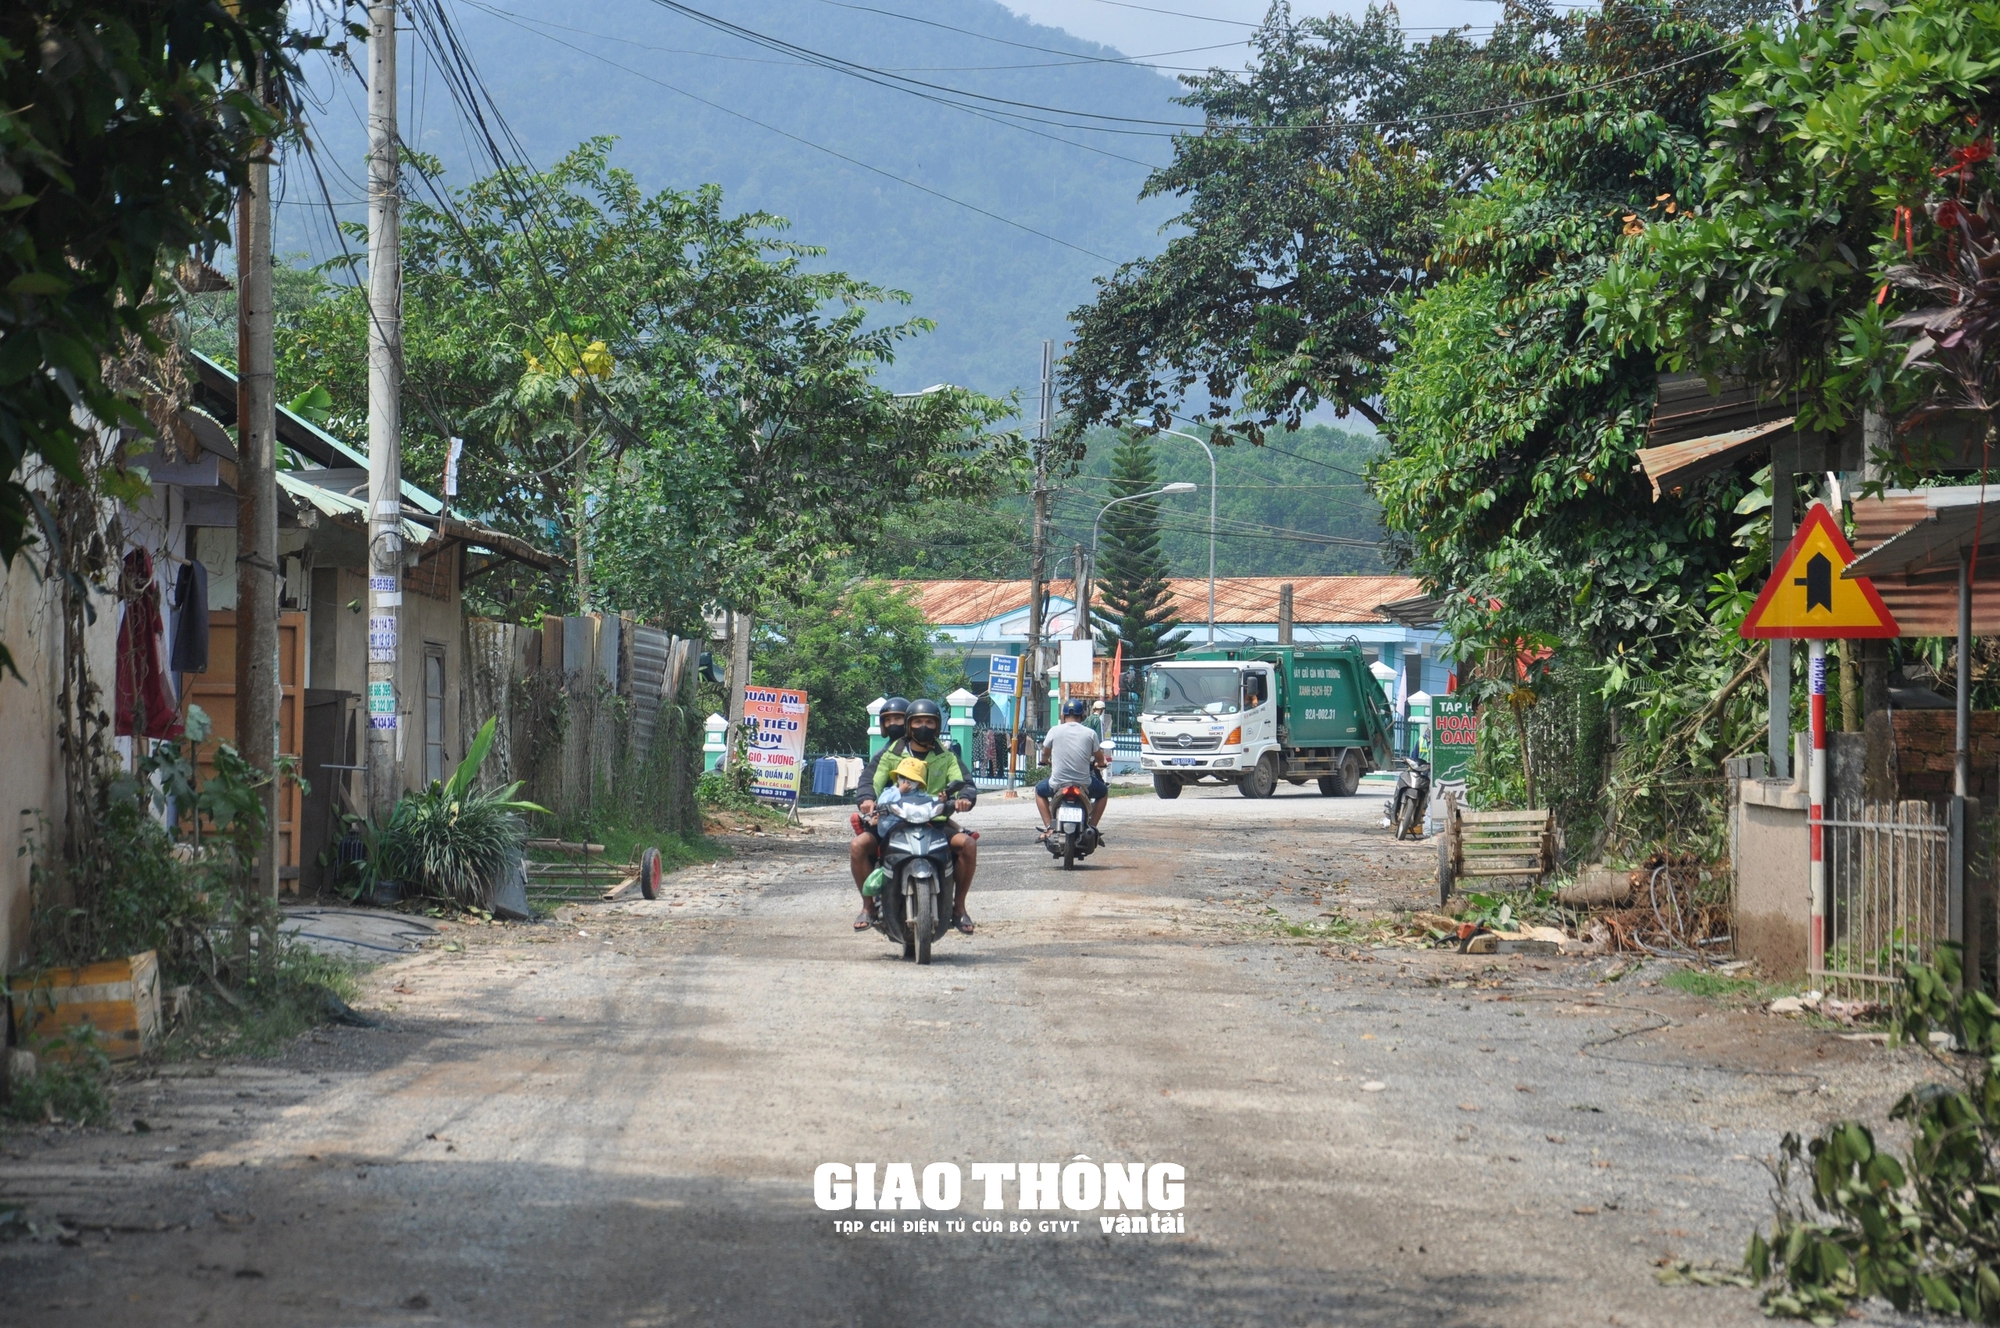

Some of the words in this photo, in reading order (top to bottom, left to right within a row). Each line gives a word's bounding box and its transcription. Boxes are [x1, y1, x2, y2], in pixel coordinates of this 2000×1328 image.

[780, 692, 798, 704] ĂN
[1305, 708, 1336, 720] 92A-002.31
[1439, 702, 1463, 715] TẠP
[763, 717, 798, 731] TIẾU
[767, 754, 795, 766] XƯƠNG
